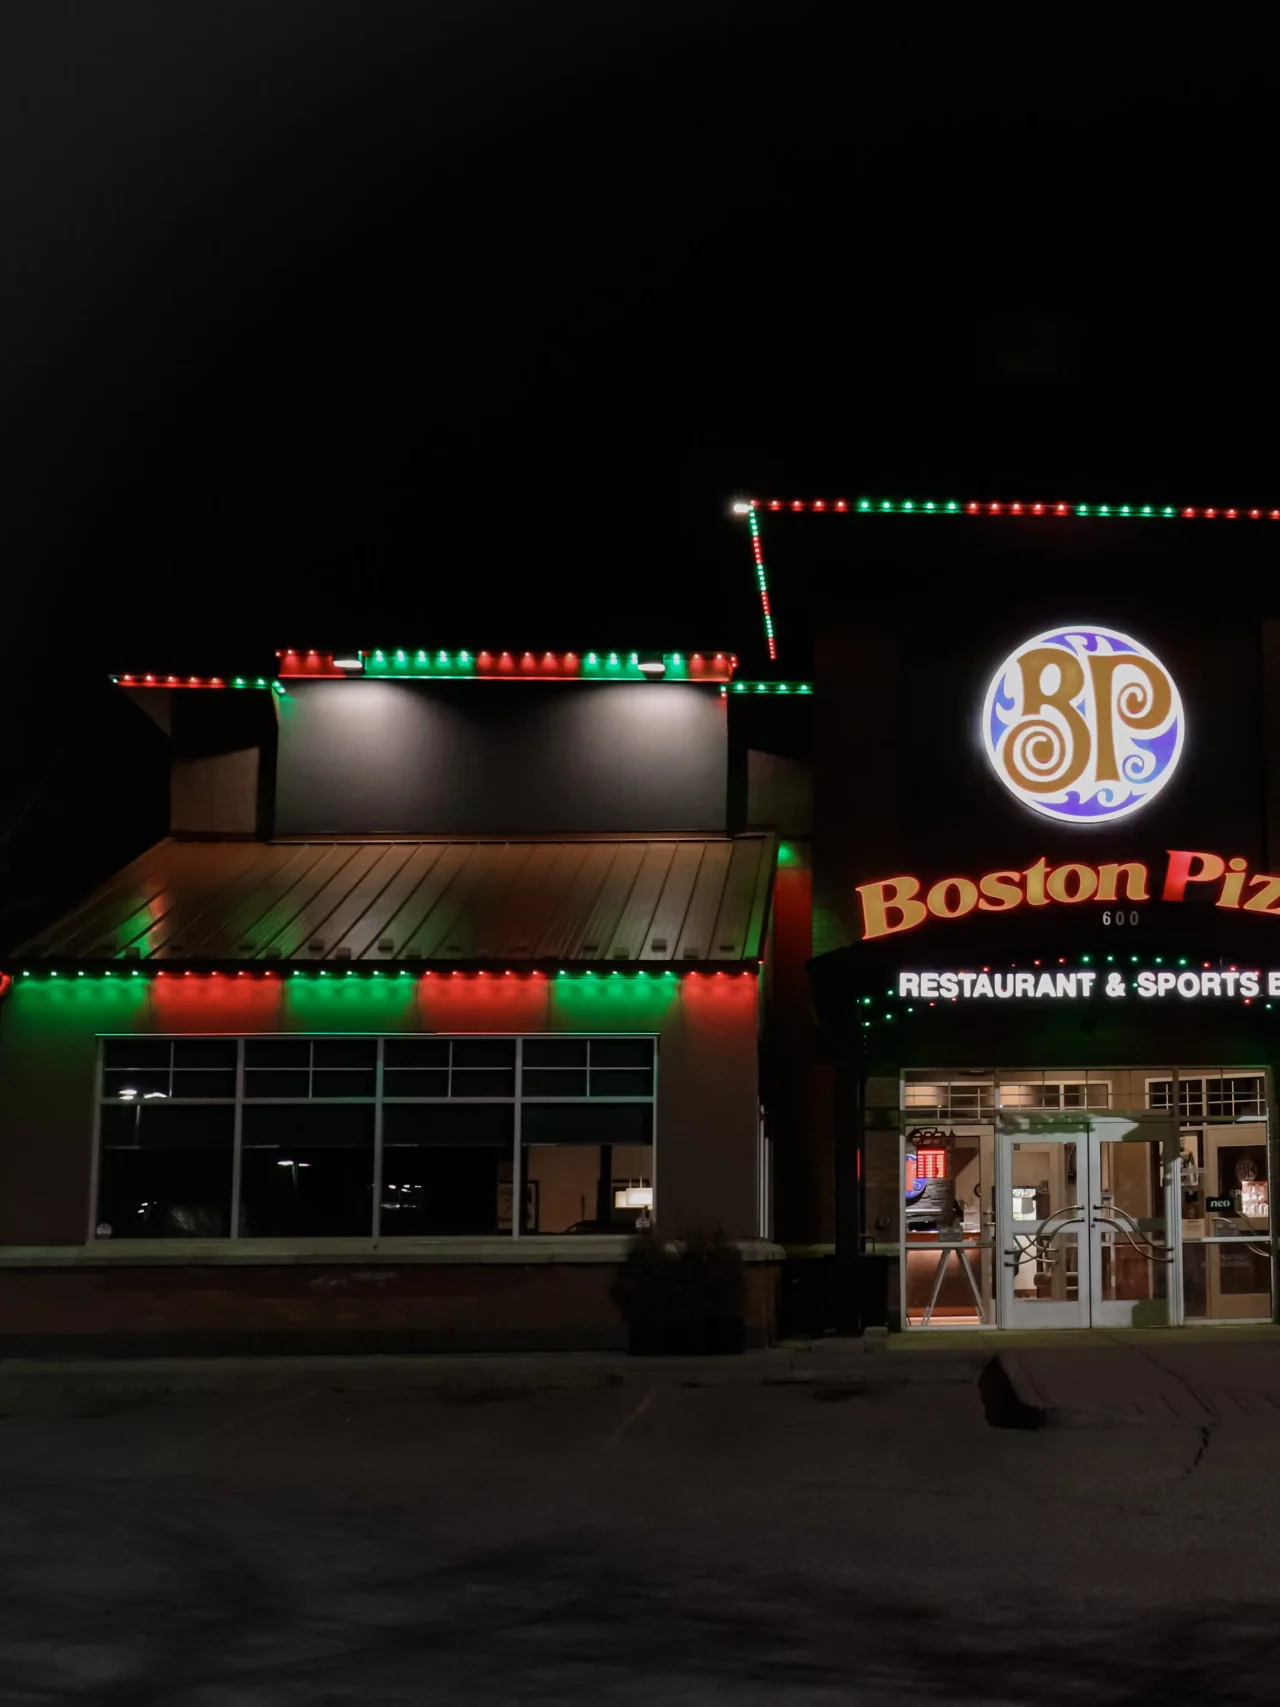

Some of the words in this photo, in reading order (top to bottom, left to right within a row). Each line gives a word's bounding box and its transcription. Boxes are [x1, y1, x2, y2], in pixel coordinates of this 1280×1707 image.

[1003, 648, 1172, 794] BP
[855, 857, 1149, 940] Boston
[1103, 911, 1139, 926] 600
[899, 972, 1096, 998] RESTAURANT
[1105, 972, 1126, 997] &
[1137, 971, 1260, 997] SPORTS
[1210, 1200, 1231, 1208] neo
